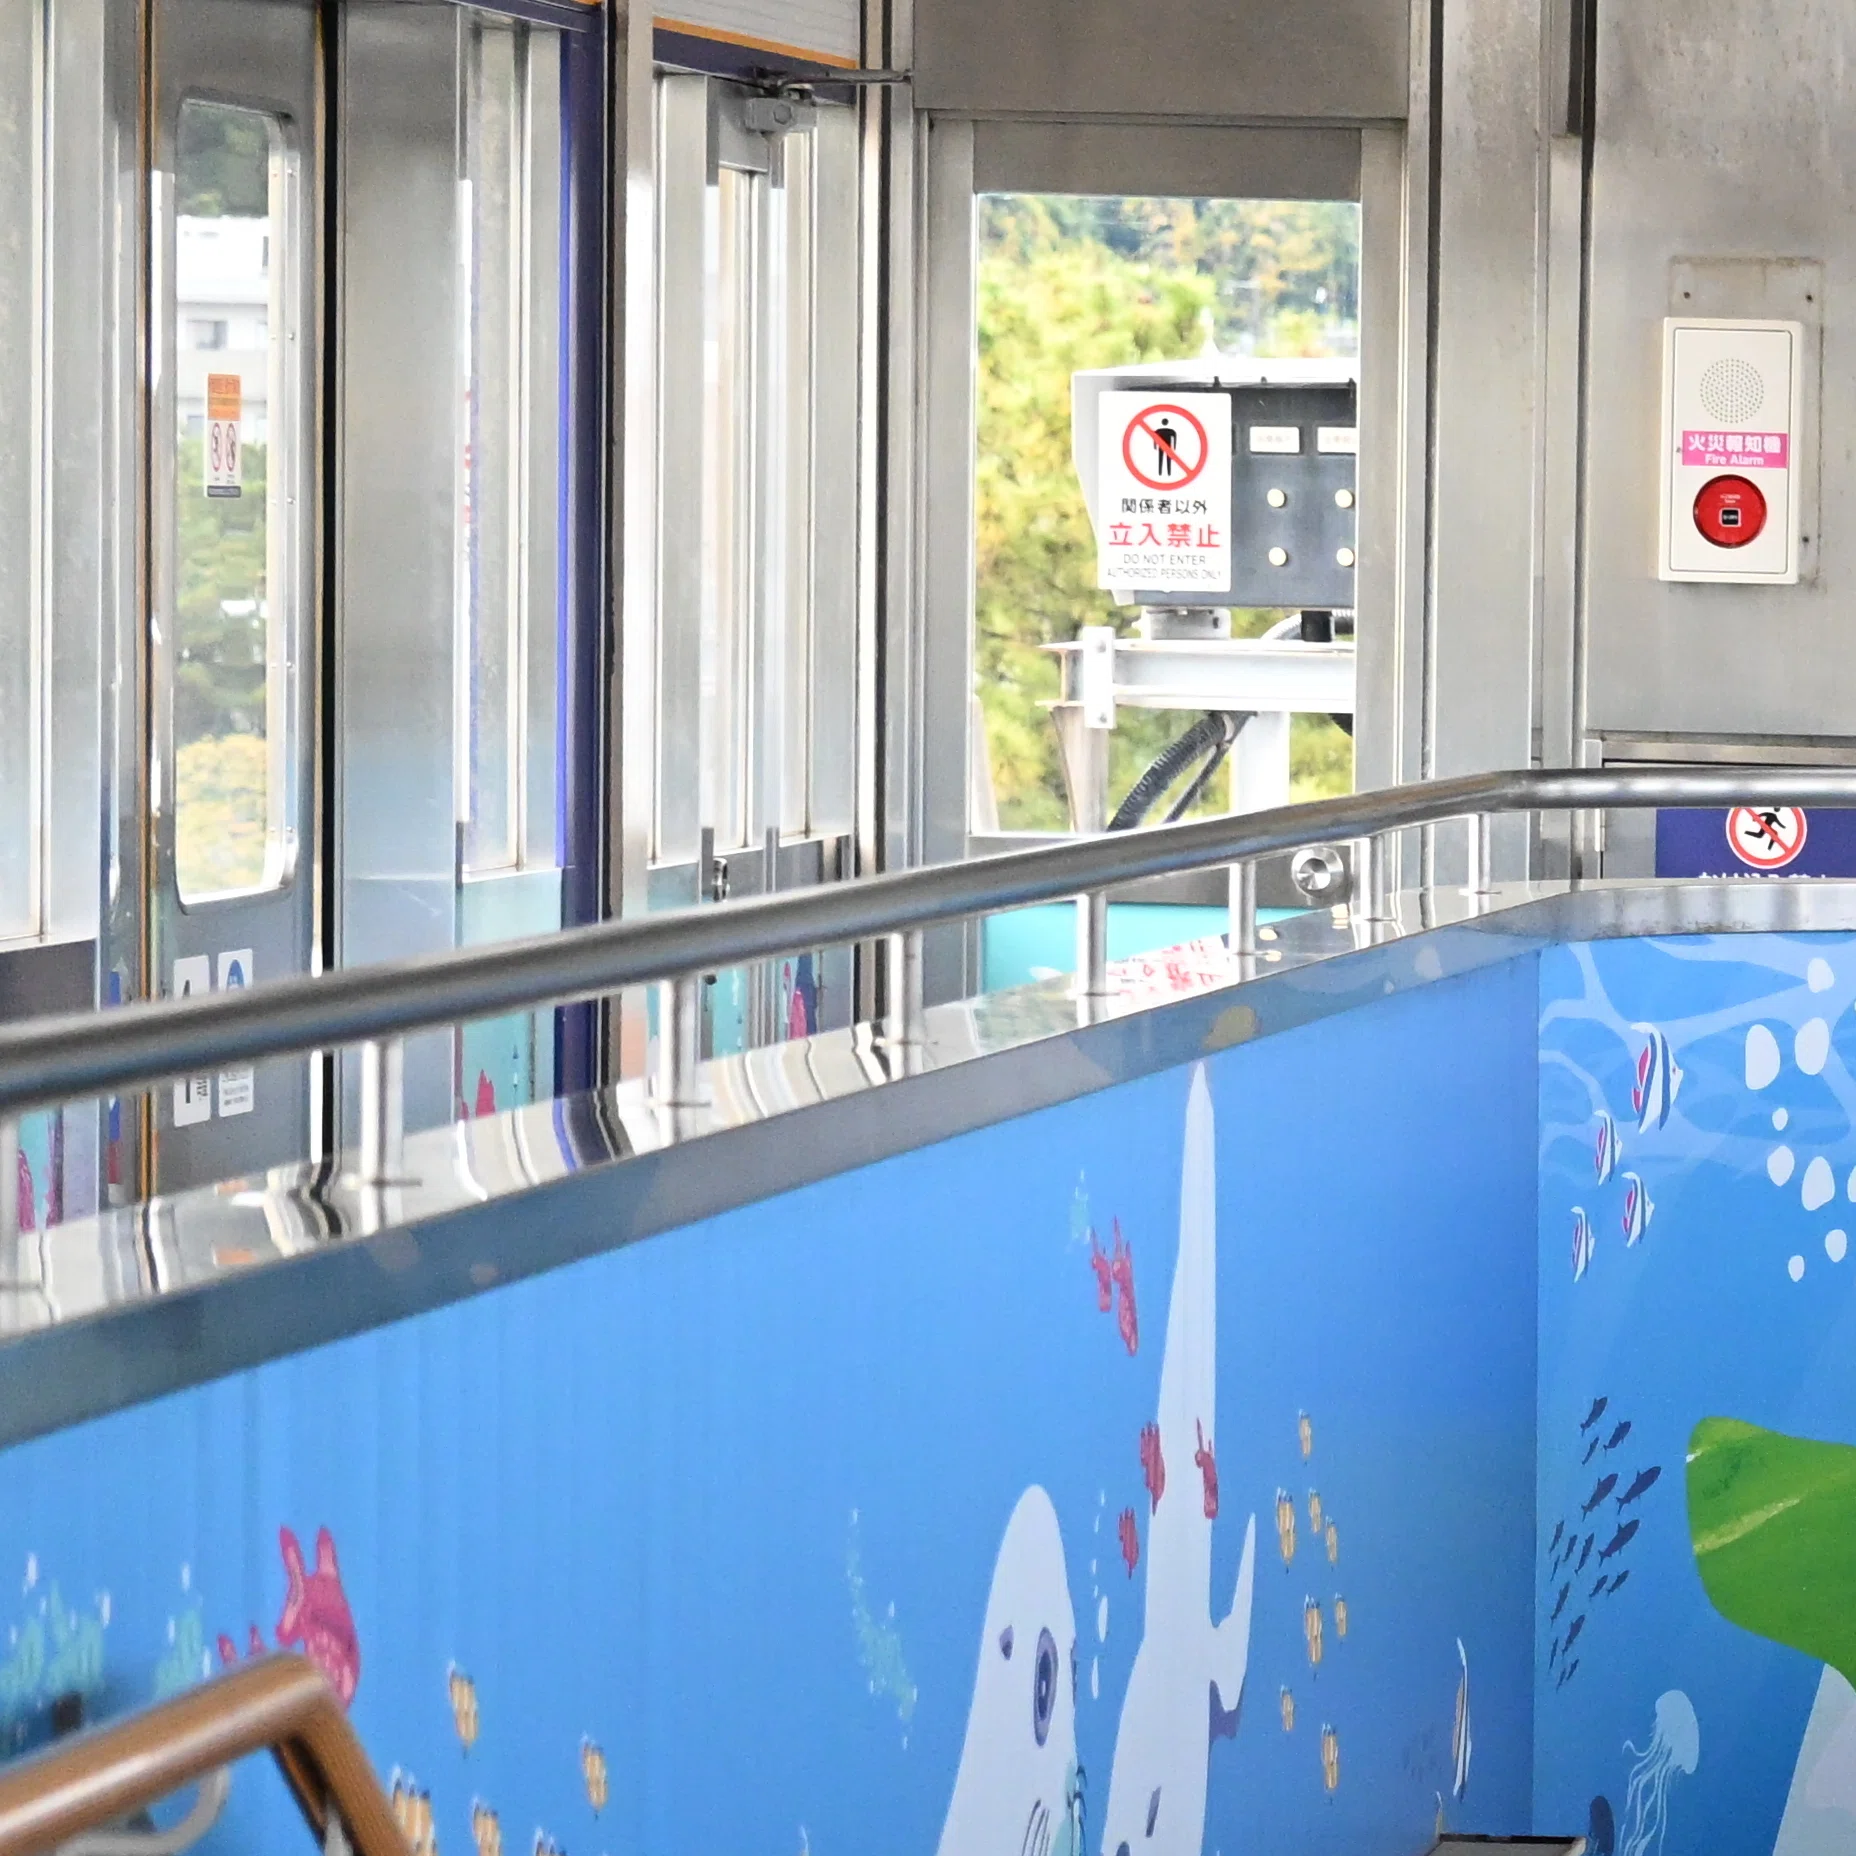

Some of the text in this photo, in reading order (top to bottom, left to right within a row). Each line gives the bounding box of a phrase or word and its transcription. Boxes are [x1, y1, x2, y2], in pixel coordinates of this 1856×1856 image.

[1705, 453, 1764, 465] Fire Alarm
[1121, 498, 1208, 514] 関係者以外
[1108, 522, 1221, 548] 立入禁止
[1123, 554, 1206, 565] DO NOT ENTER
[1107, 567, 1158, 578] AUTHORIZED
[1161, 568, 1199, 579] PERSONS
